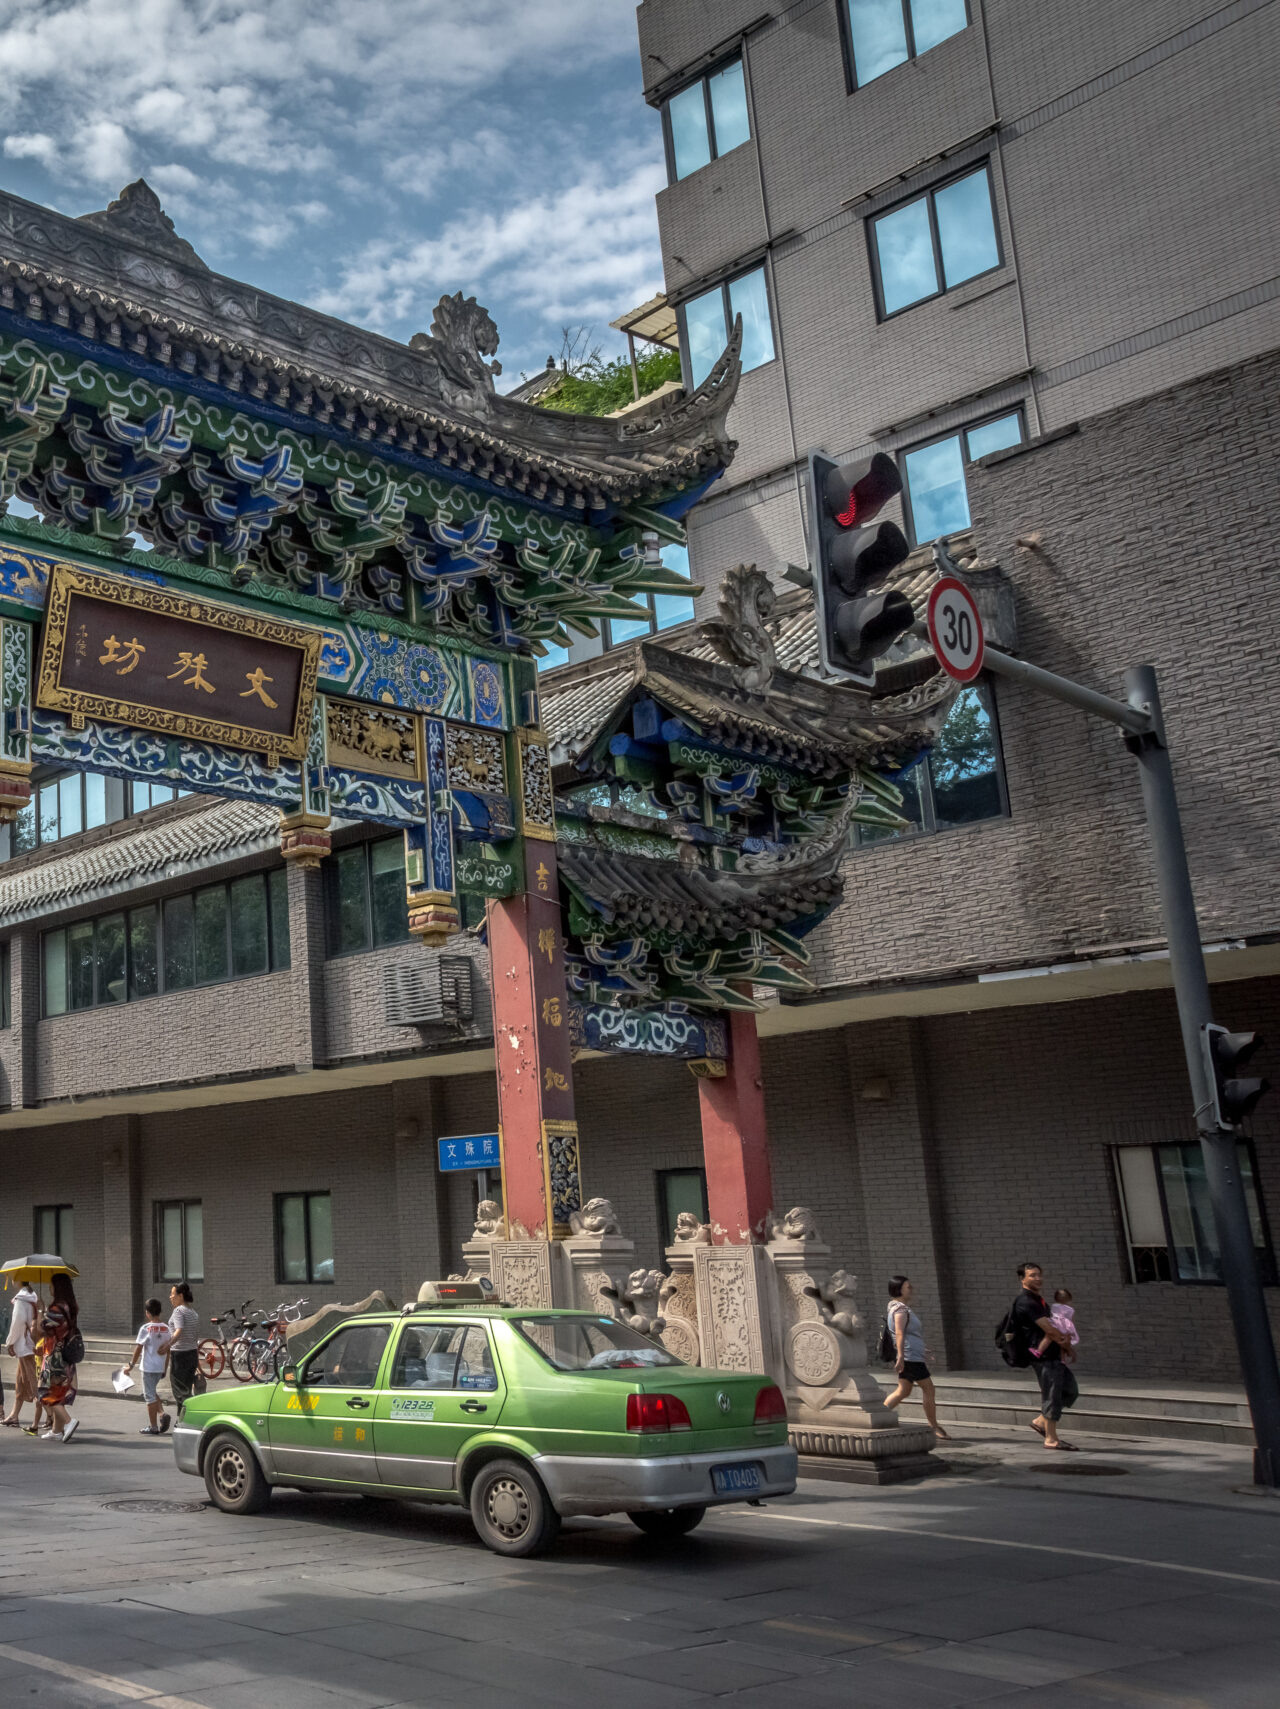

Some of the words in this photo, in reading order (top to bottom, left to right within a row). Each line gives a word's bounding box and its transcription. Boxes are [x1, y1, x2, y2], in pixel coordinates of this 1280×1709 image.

[942, 604, 972, 656] 30
[98, 634, 279, 709] 文殊坊
[447, 1139, 494, 1158] 文殊院
